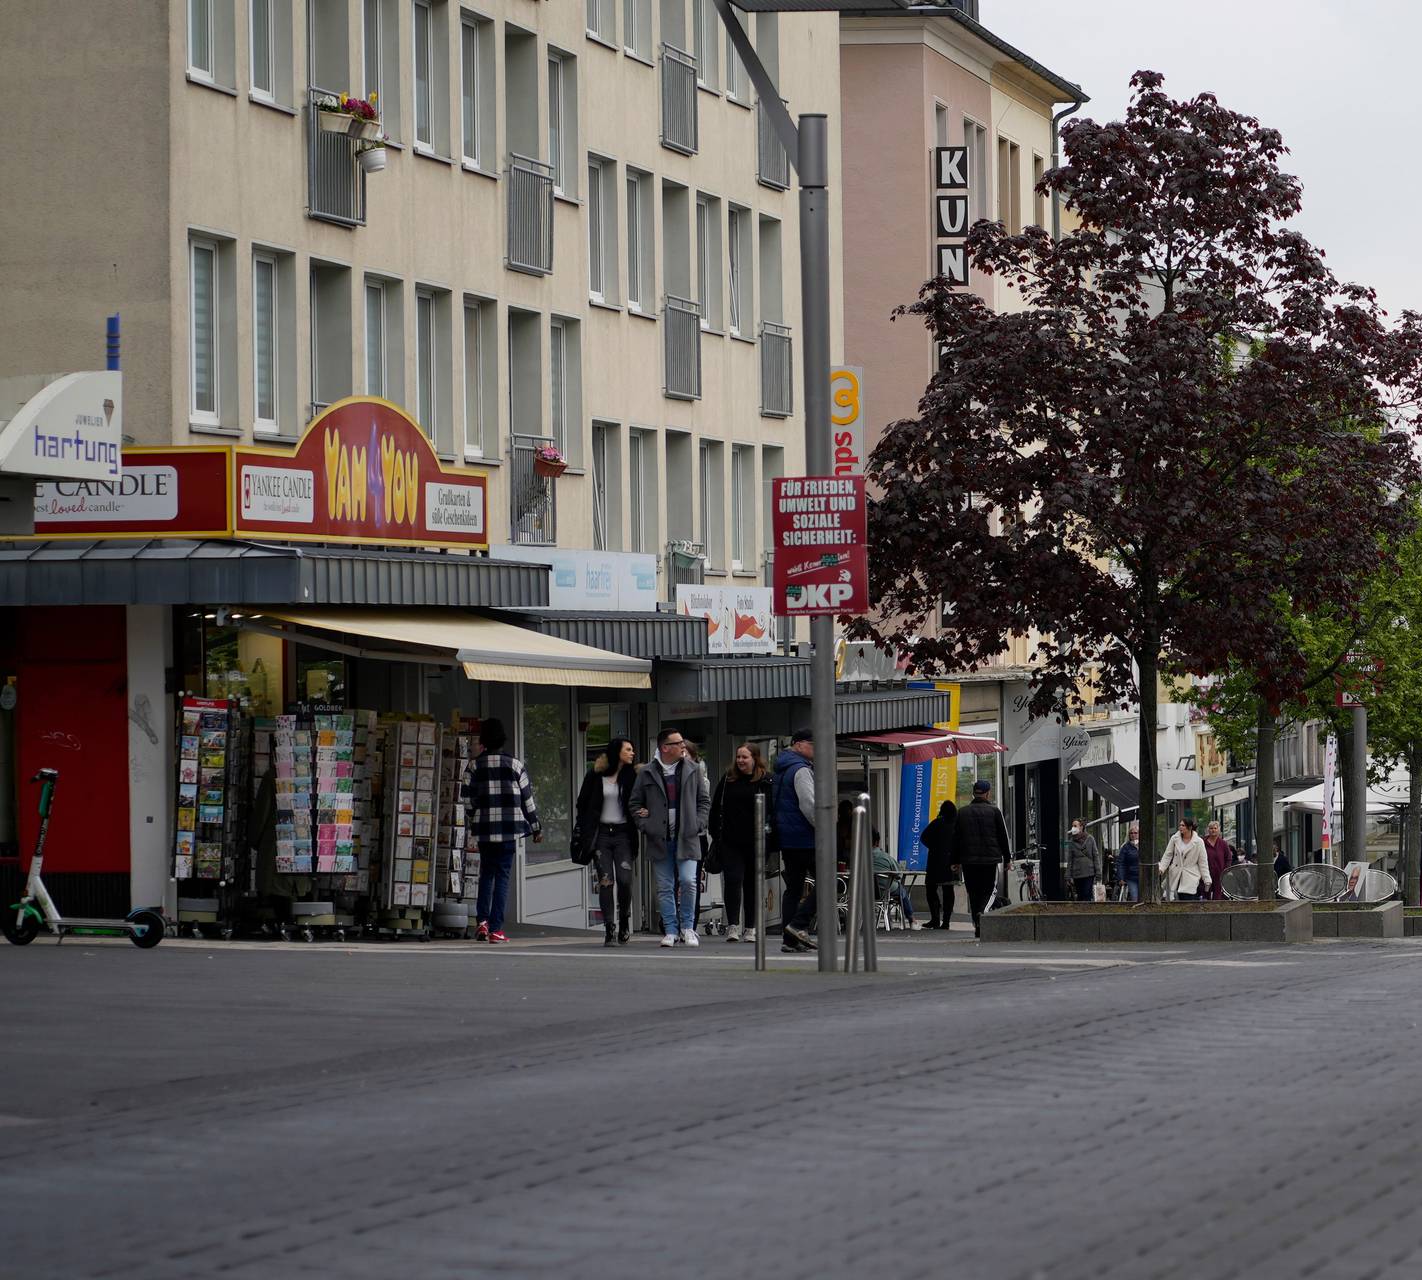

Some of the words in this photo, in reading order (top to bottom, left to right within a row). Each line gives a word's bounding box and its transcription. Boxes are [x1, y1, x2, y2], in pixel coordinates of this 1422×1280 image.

[35, 425, 118, 474] hartung
[55, 473, 168, 497] CANDLE
[324, 427, 367, 521] YAM
[381, 433, 419, 526] YOU
[251, 474, 281, 498] YANKEE
[282, 476, 312, 500] CANDLE
[781, 480, 802, 497] FÜR
[804, 479, 857, 496] FRIEDEN,
[49, 496, 87, 515] loved
[438, 488, 466, 507] Grußkarten
[466, 490, 472, 507] &
[779, 497, 826, 513] UMWELT
[829, 496, 856, 511] UND
[443, 508, 478, 527] Geschenkideen
[792, 513, 840, 529] SOZIALE
[782, 529, 857, 546] SICHERHEIT:
[786, 583, 854, 609] DKP
